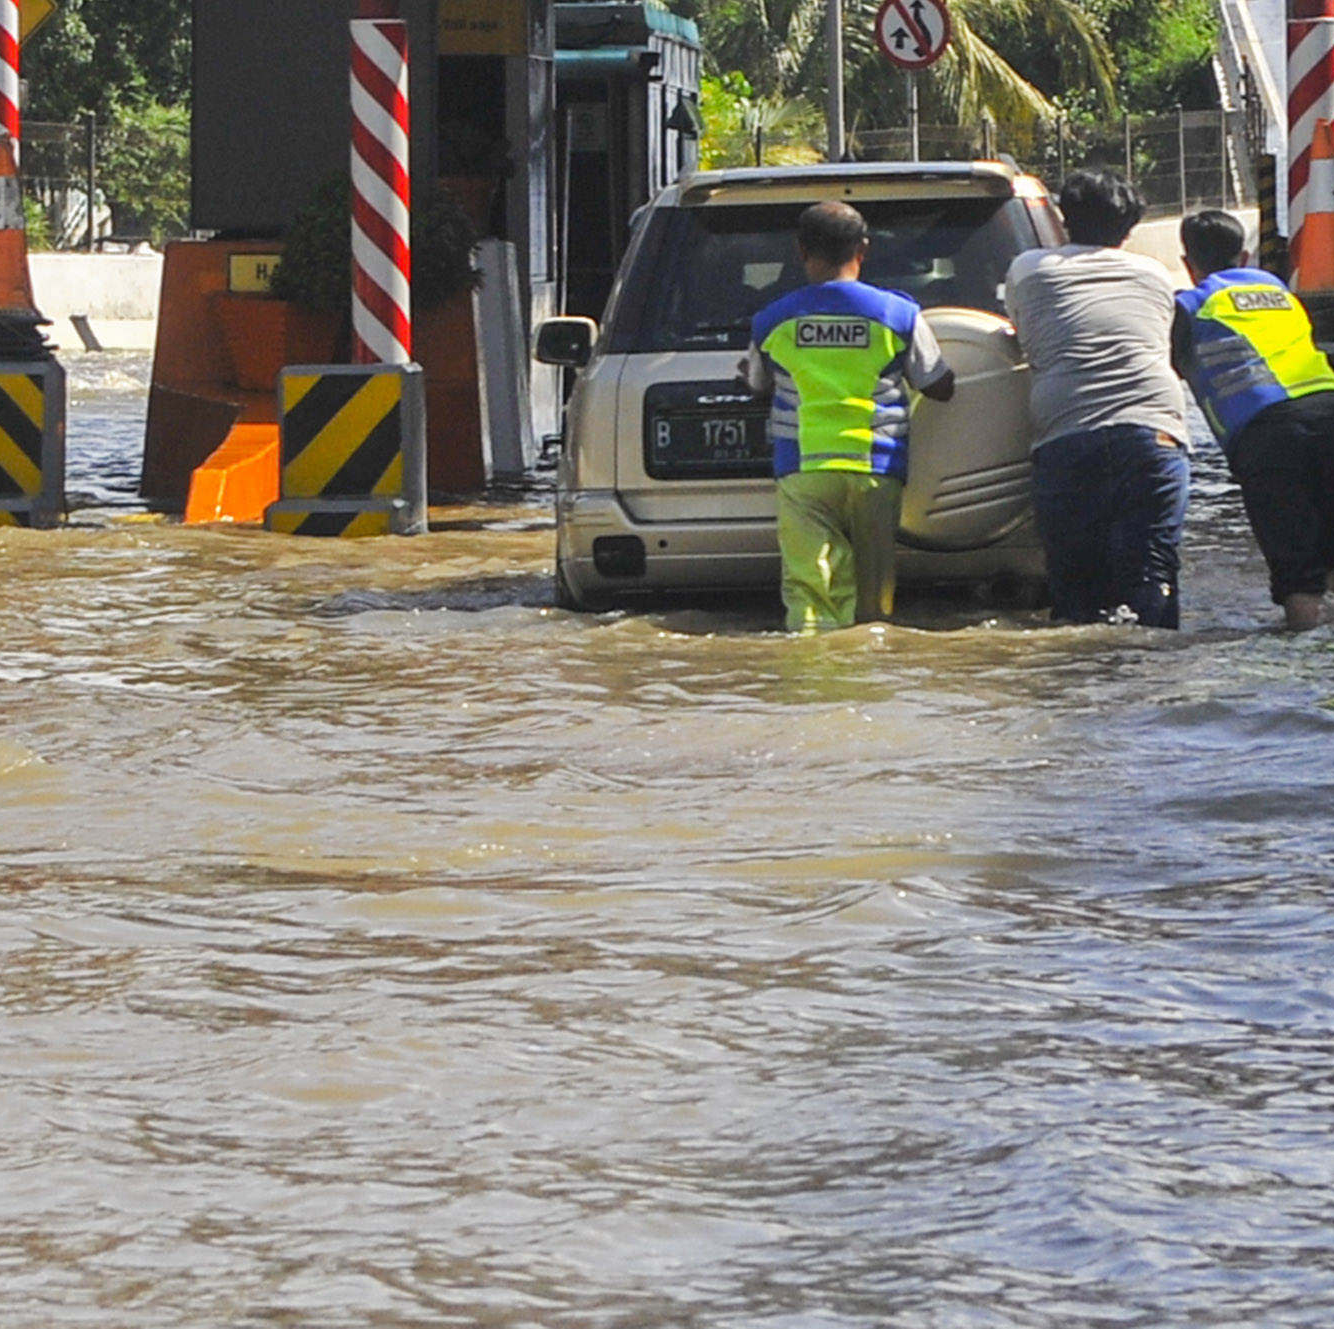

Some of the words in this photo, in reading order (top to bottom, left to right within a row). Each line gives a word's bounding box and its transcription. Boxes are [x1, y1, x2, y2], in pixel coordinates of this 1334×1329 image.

[799, 322, 866, 344] CMNP
[656, 420, 672, 448] B
[702, 418, 747, 447] 1751
